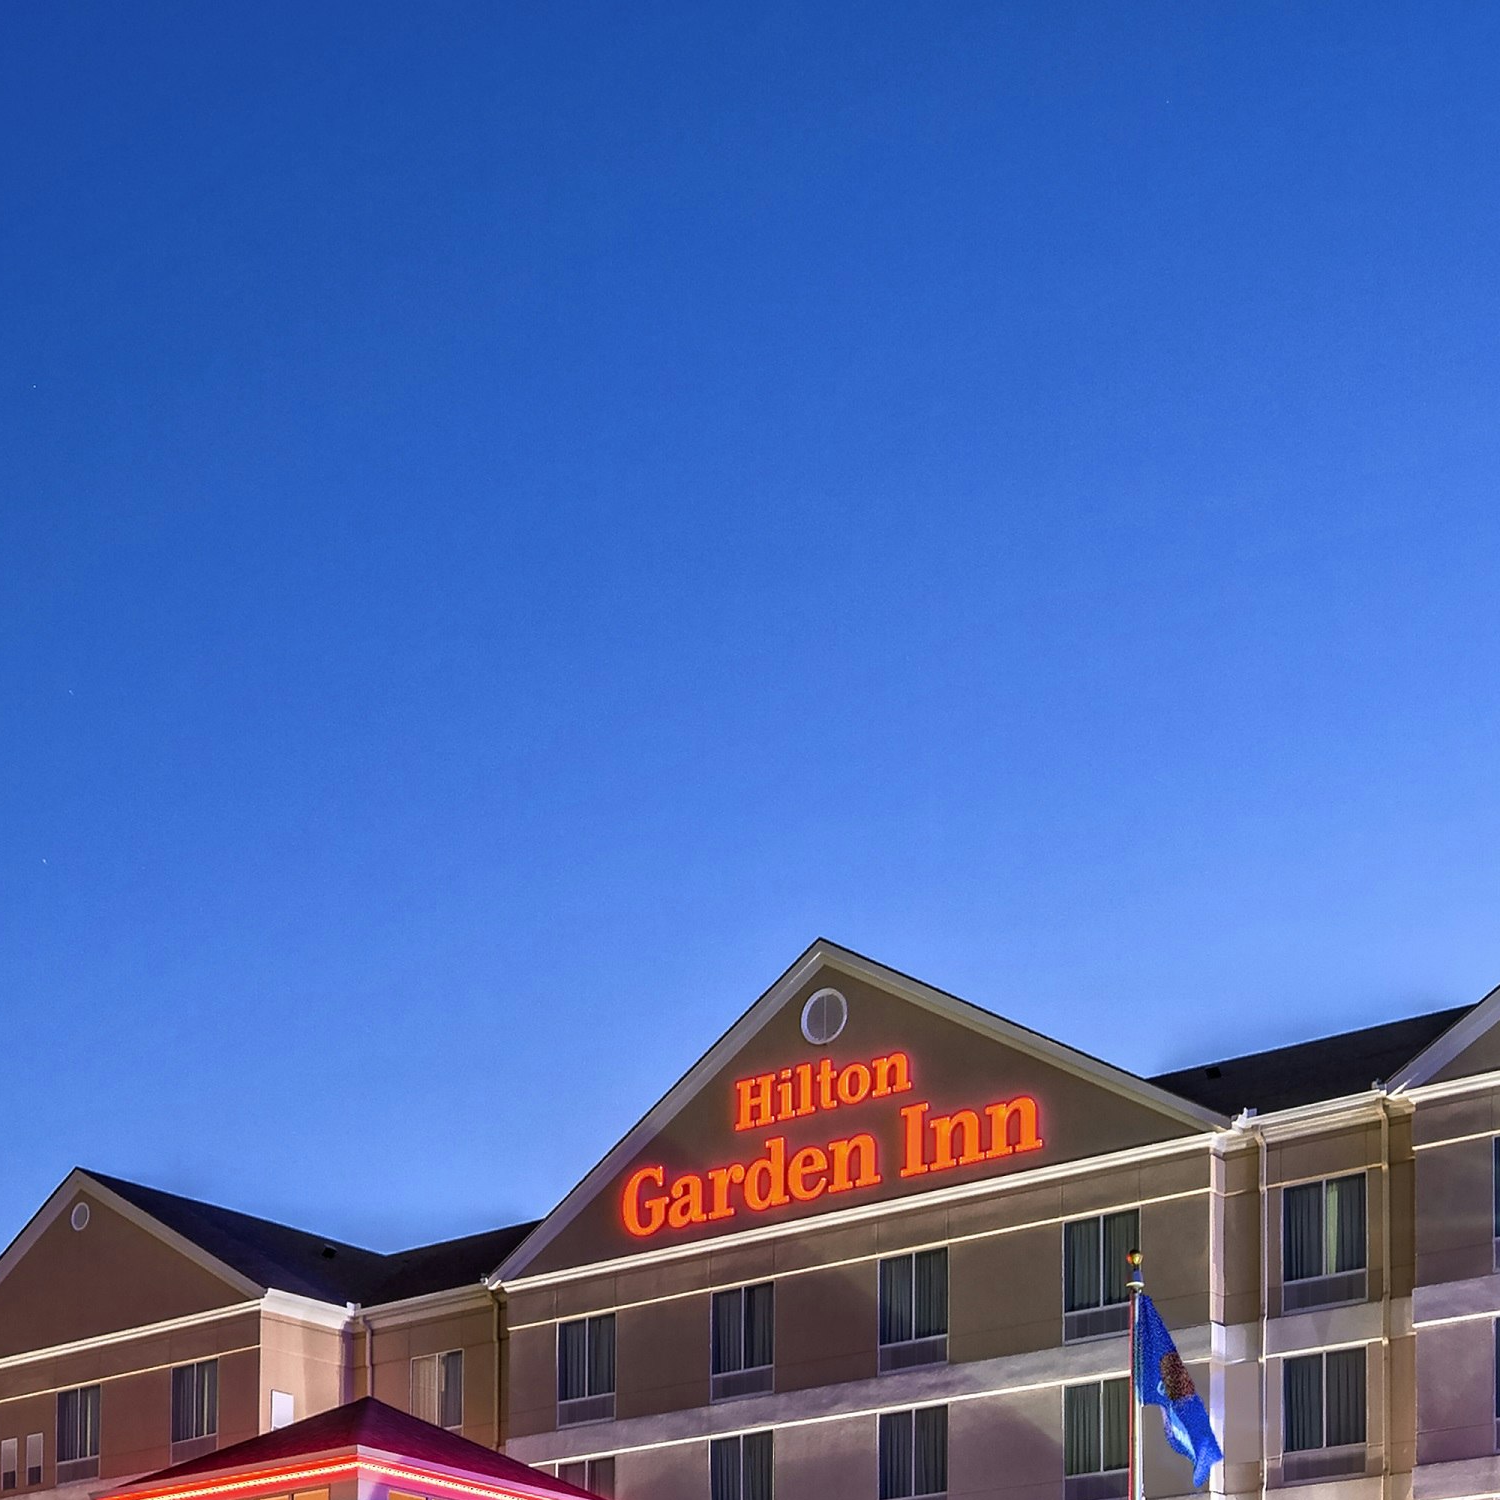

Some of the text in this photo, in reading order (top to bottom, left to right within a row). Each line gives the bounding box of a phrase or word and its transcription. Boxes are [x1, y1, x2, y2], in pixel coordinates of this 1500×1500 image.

[734, 1050, 913, 1131] Hilton
[622, 1095, 1044, 1237] Garden Inn
